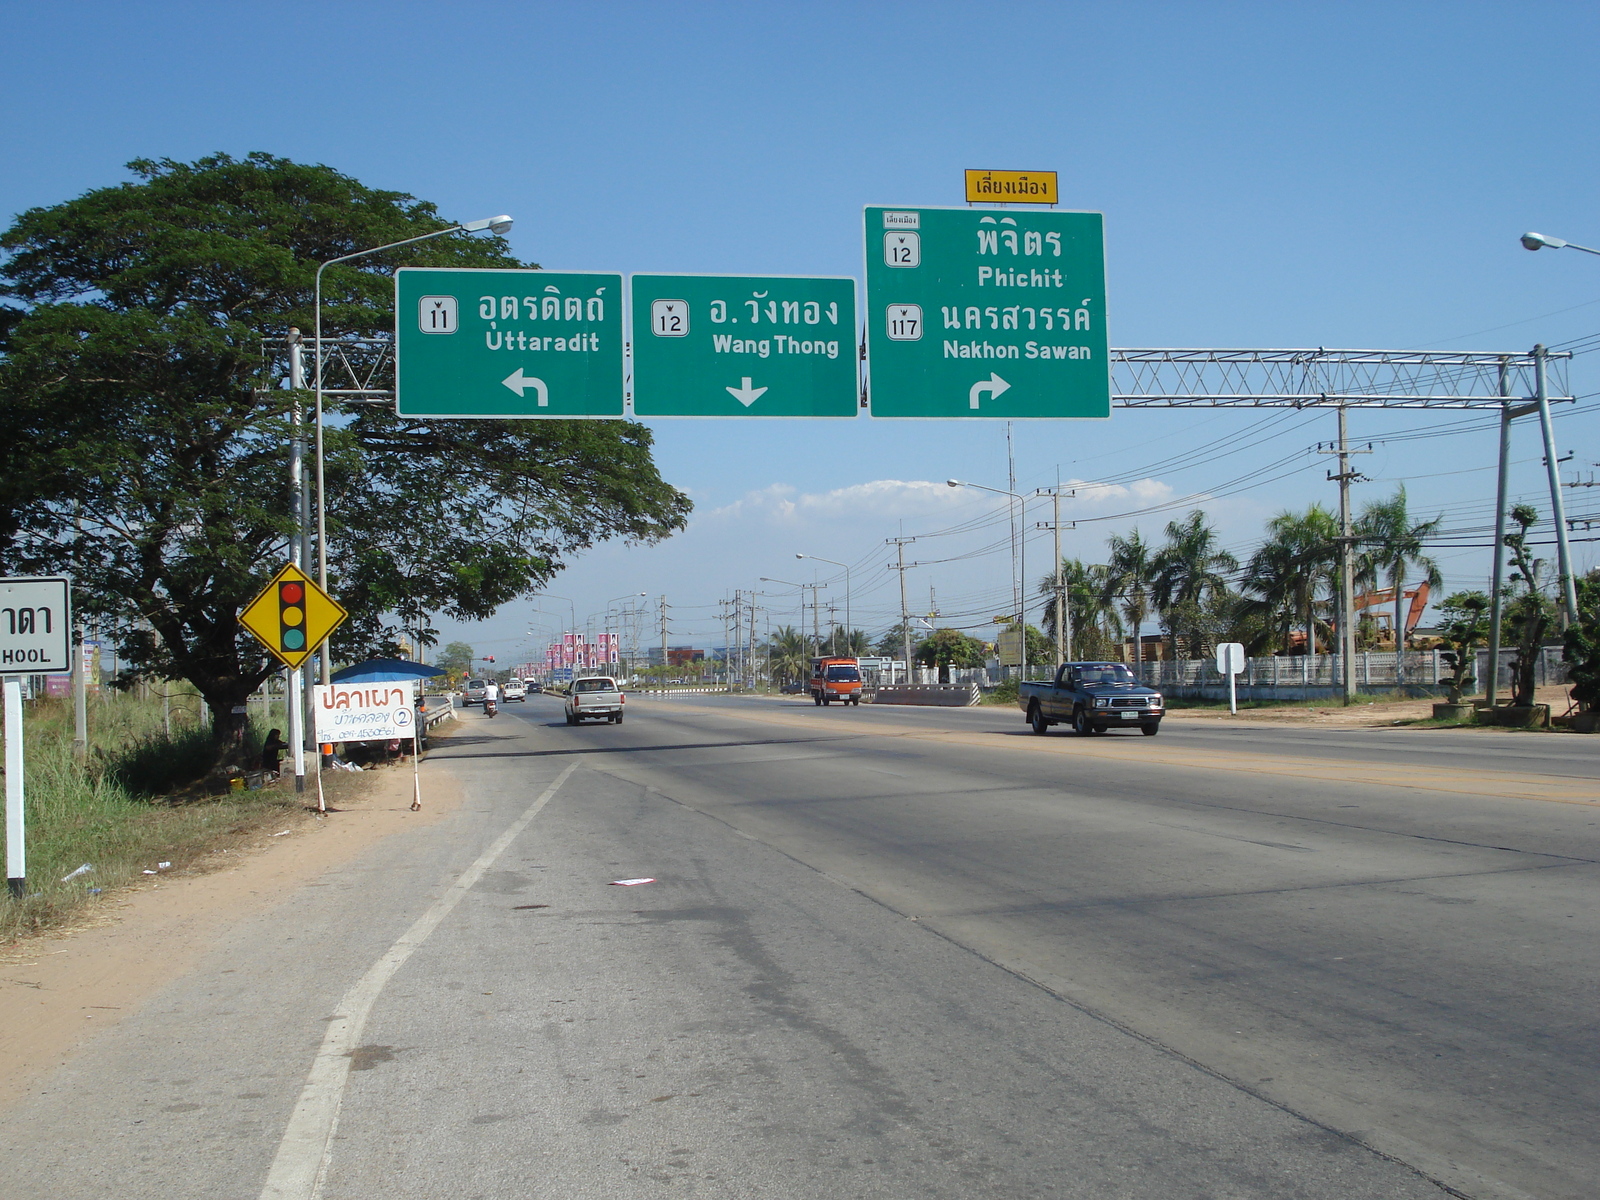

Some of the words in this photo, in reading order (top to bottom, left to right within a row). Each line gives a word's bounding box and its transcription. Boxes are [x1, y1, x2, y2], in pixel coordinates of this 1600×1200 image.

[976, 172, 1048, 196] เลี่ยงเมือง
[976, 216, 1062, 257] พิจิตร
[893, 247, 911, 263] 12
[978, 266, 1063, 288] Phichit
[479, 285, 607, 329] อุตรดิตถ์
[941, 298, 1091, 331] นครสวรรค์
[431, 310, 447, 329] 11
[660, 316, 681, 332] 12
[891, 320, 918, 336] 117
[486, 331, 599, 352] Uttaradit
[713, 335, 770, 359] Wang
[774, 335, 839, 359] Thong
[943, 340, 1019, 360] Nakhon
[1024, 340, 1091, 360] Sawan
[322, 685, 404, 710] ปลาเผา
[398, 711, 408, 725] 2
